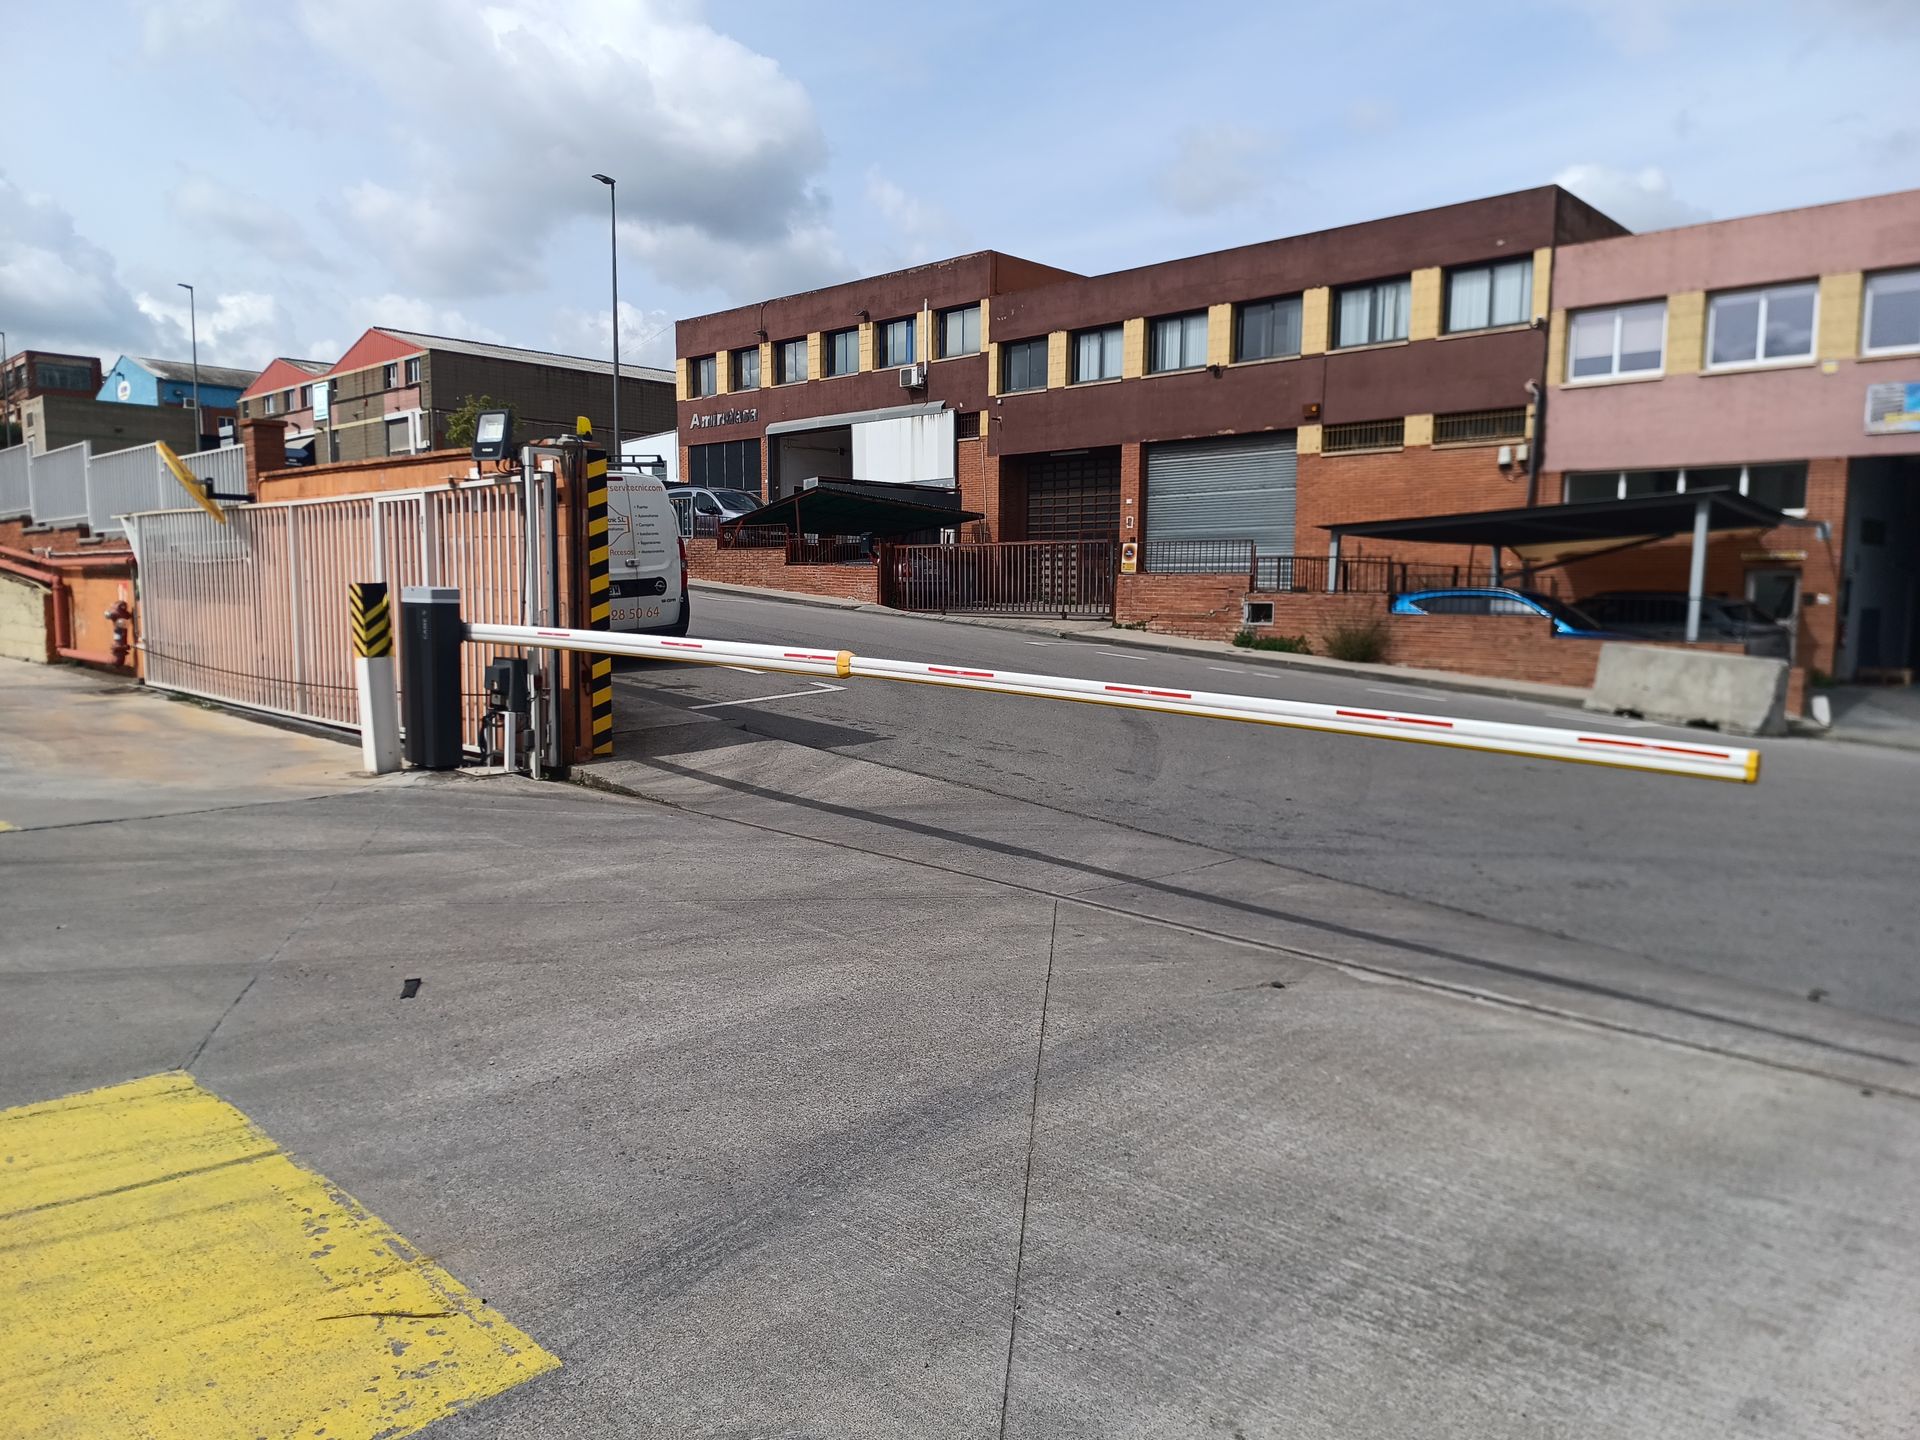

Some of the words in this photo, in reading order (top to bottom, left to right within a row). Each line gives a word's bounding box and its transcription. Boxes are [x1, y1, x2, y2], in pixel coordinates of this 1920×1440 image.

[611, 609, 626, 621] 28
[628, 607, 643, 620] 50
[646, 606, 660, 618] 64
